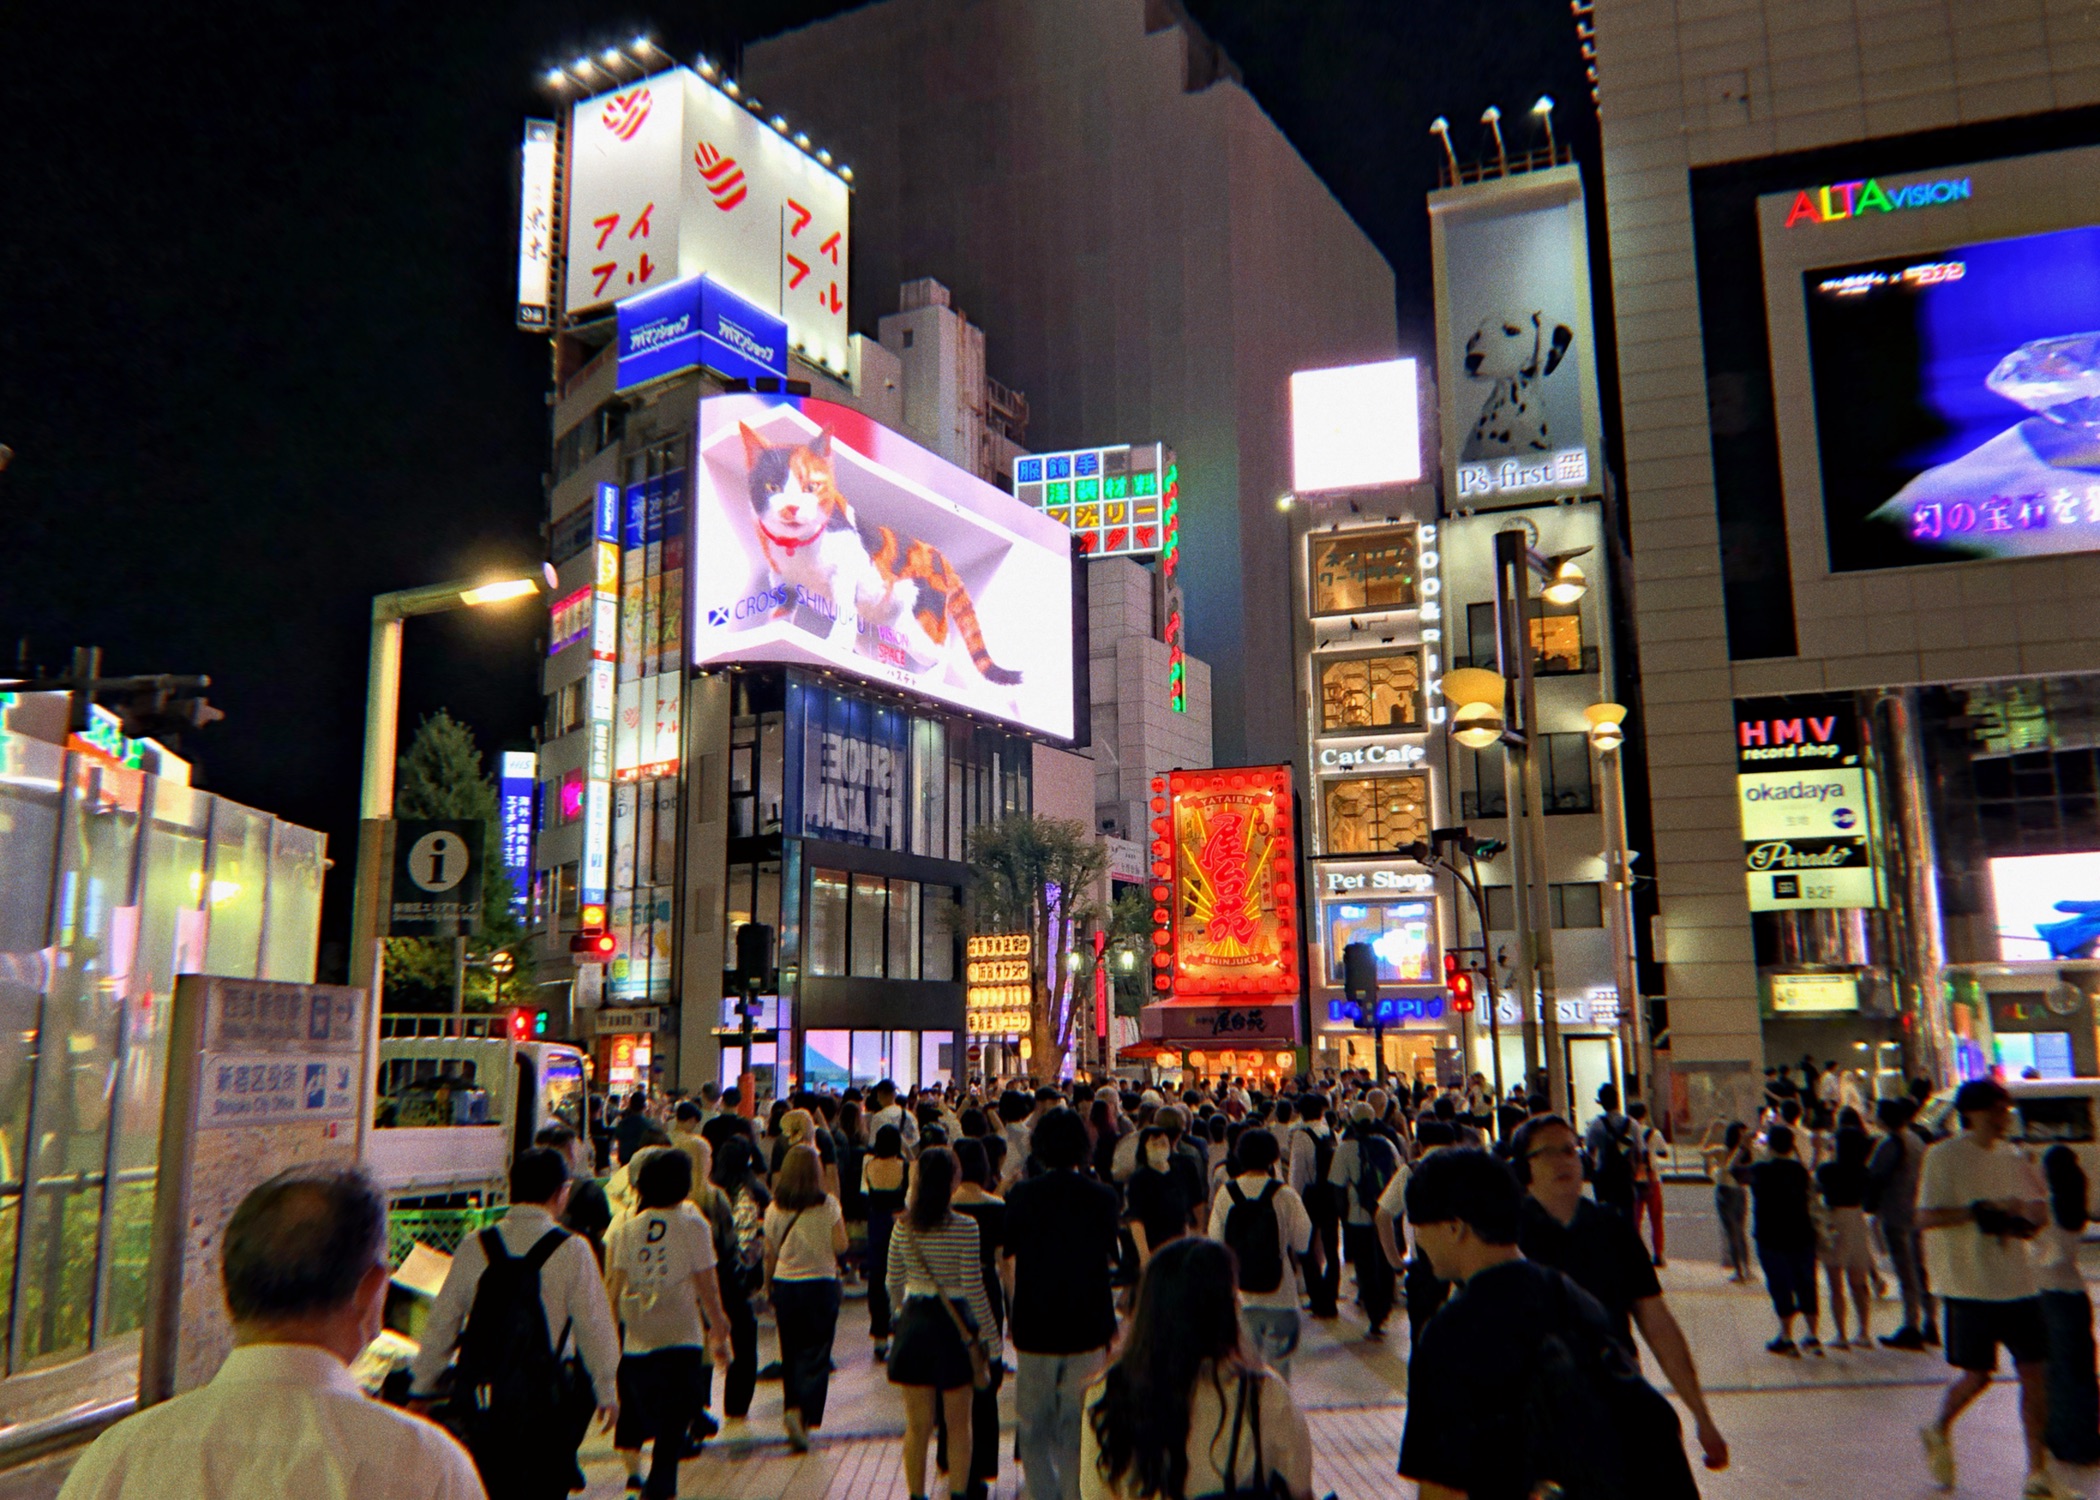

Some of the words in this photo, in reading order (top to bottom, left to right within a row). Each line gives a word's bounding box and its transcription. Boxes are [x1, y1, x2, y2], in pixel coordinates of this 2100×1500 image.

[1784, 178, 1893, 228] ALTA
[1889, 177, 1973, 209] VISION
[593, 202, 654, 250] アイ
[787, 198, 841, 265] アイ
[591, 253, 654, 297] フル
[787, 253, 842, 315] フル
[1457, 460, 1554, 494] P's-first
[734, 583, 787, 620] CROSS
[795, 583, 865, 634] SHINJUU
[877, 643, 907, 667] SPACE
[1739, 716, 1836, 746] HMV
[1320, 747, 1365, 766] Cat
[1366, 744, 1425, 764] Cafe
[1742, 745, 1797, 760] record
[1798, 743, 1840, 758] shop
[1201, 795, 1253, 806] YATAIEN
[1745, 782, 1844, 802] okadaya
[1327, 872, 1365, 890] Pet
[1372, 869, 1432, 892] Shop
[1204, 954, 1259, 966] SHINJUKU
[1999, 1002, 2048, 1020] ALA
